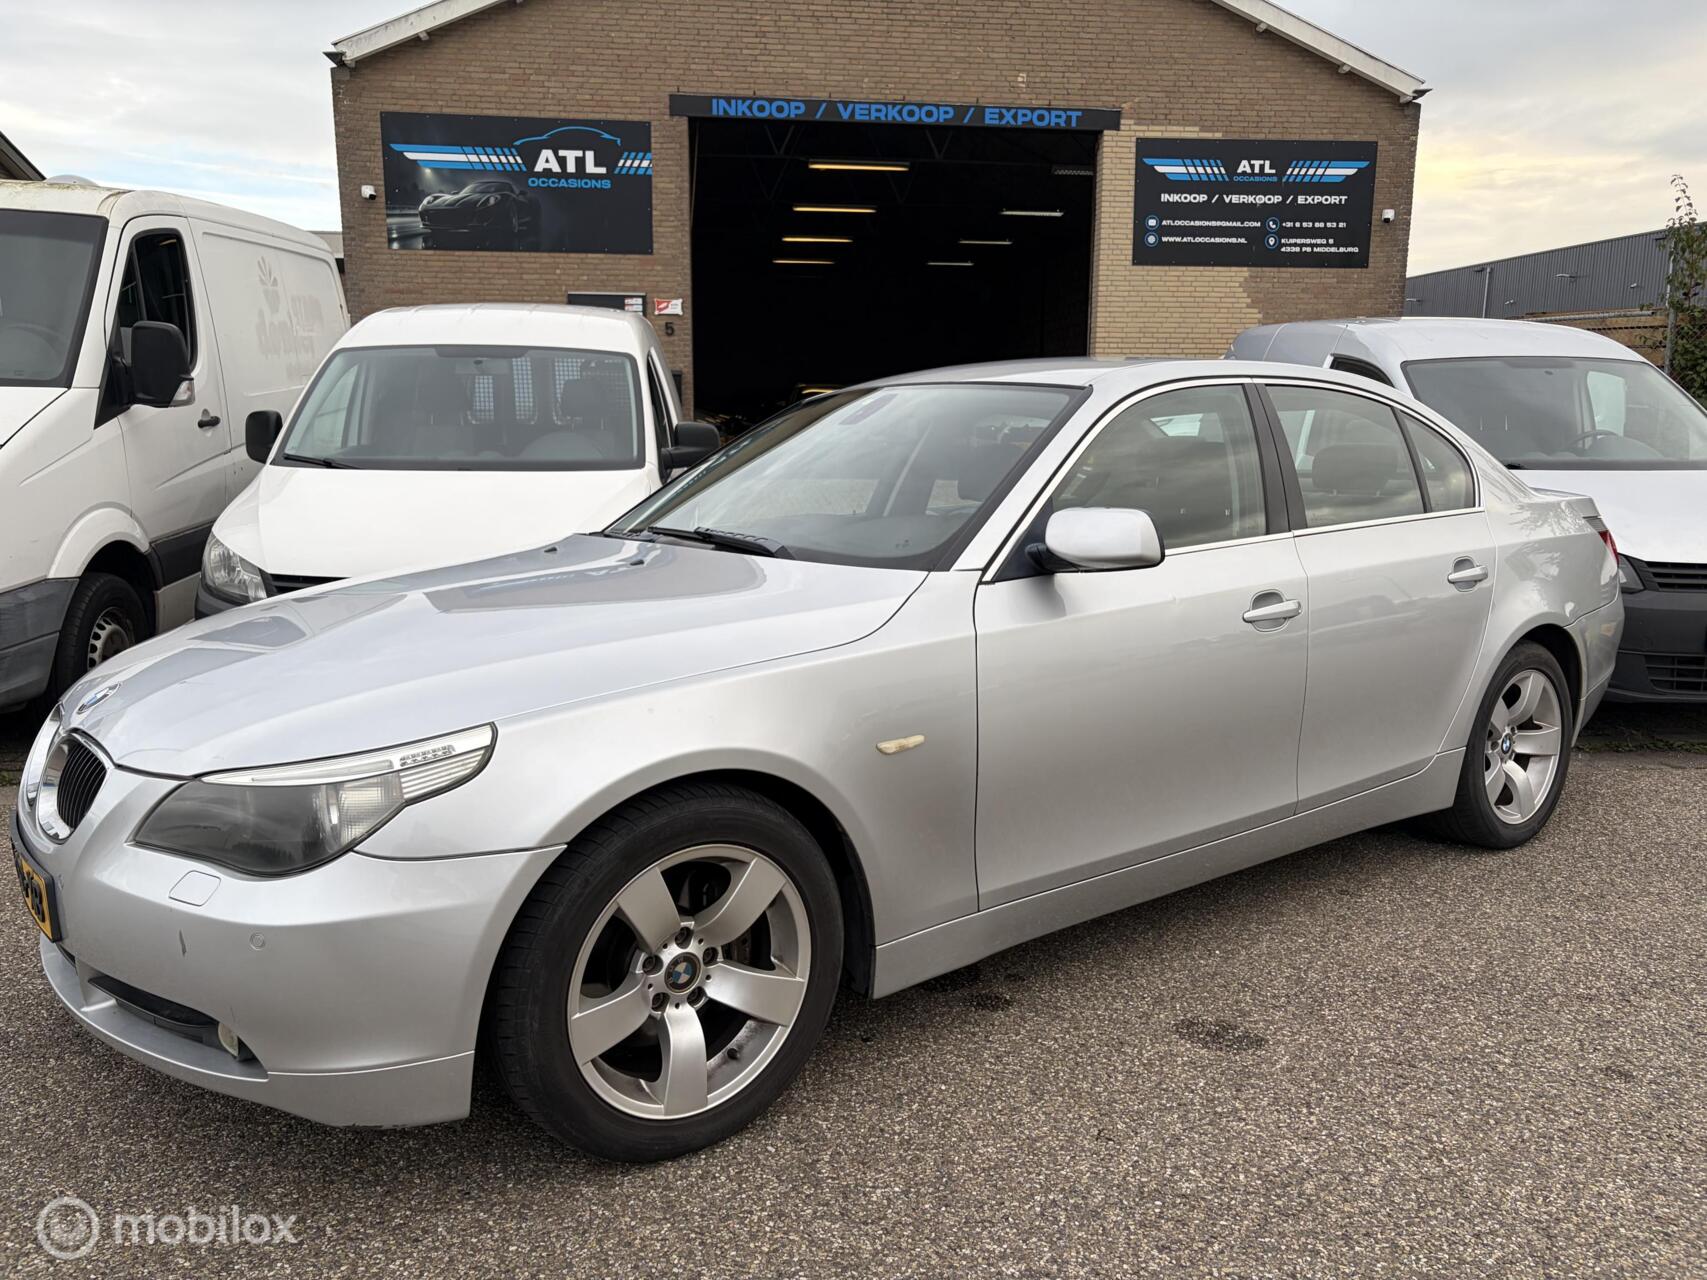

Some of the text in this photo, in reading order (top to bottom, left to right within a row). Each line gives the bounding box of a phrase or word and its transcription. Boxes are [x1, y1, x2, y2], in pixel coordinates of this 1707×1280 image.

[711, 99, 1083, 127] INKOOP / VERKOOP / EXPORT
[534, 149, 606, 173] ATL
[1237, 160, 1276, 173] ATL
[528, 178, 611, 188] OCCASIONS
[1161, 193, 1348, 204] INKOOP / VERKOOP / EXPORT
[1162, 220, 1260, 228] ATLOCCASIONS@GMAIL.COM
[1162, 236, 1247, 244] WWW.ATLOCCASIONS.NL
[665, 322, 675, 336] 5
